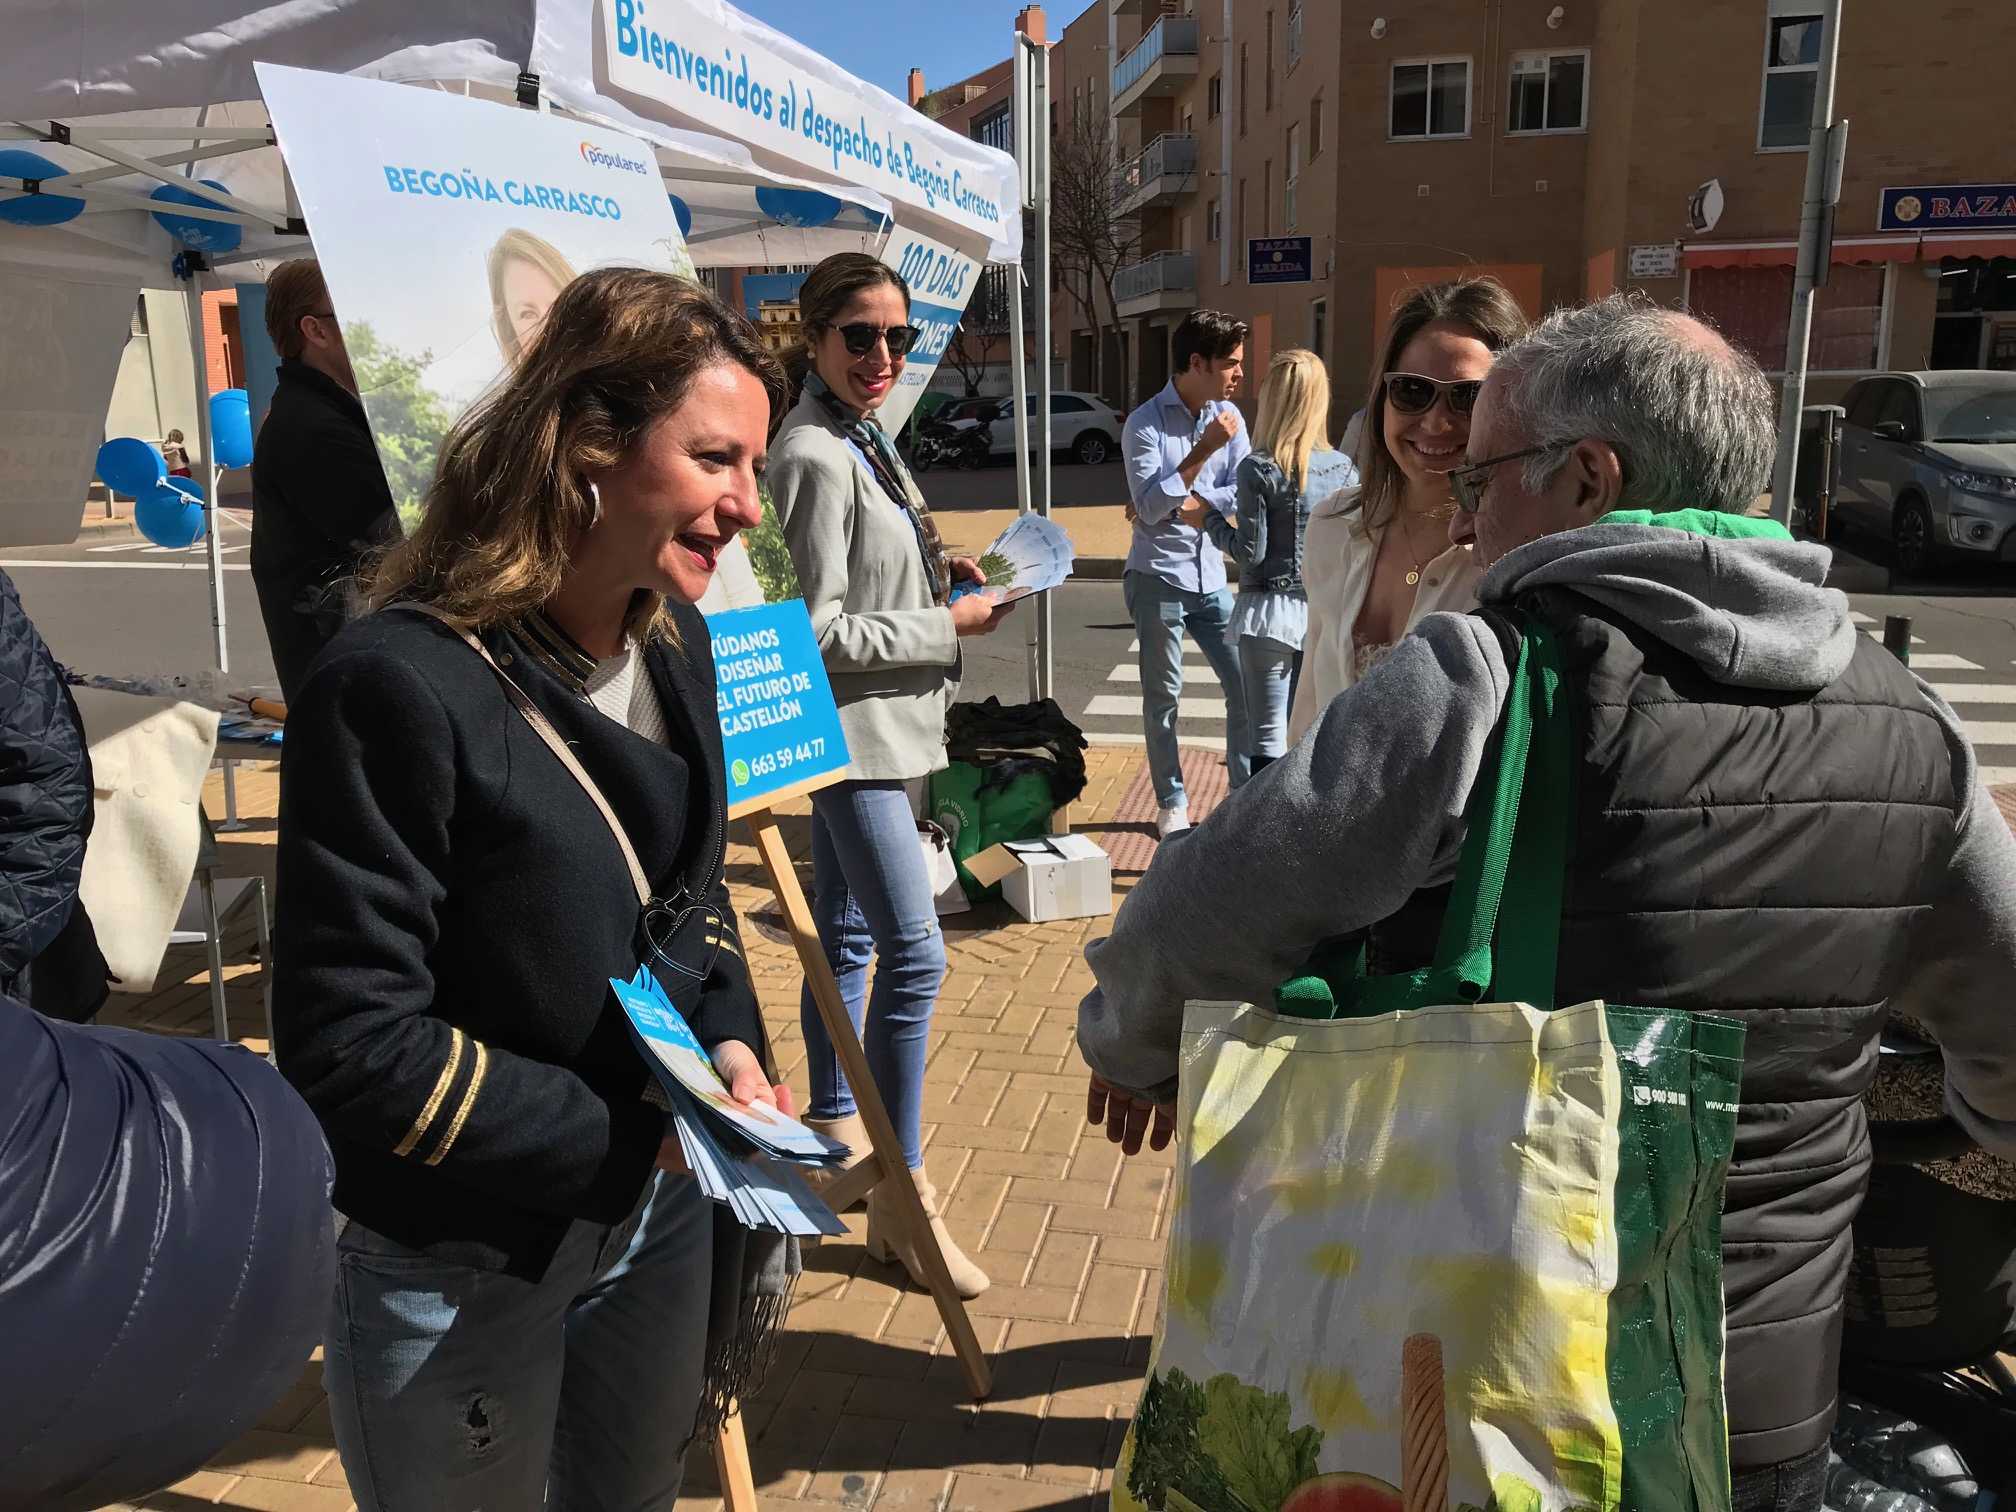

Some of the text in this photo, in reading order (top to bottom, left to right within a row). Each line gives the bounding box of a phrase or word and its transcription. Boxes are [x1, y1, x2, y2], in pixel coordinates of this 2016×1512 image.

[615, 0, 999, 224] Bienvenidos al despacho de Begoña Carrasco
[588, 148, 647, 175] populares
[383, 166, 622, 221] BEGOÑA CARRASCO
[898, 241, 971, 300] 100 DÍAS
[718, 651, 785, 684] DISEÑAR
[717, 671, 812, 712] EL FUTURO DE
[720, 697, 803, 737] CASTELLÓN
[751, 737, 825, 777] 663 59 44 77
